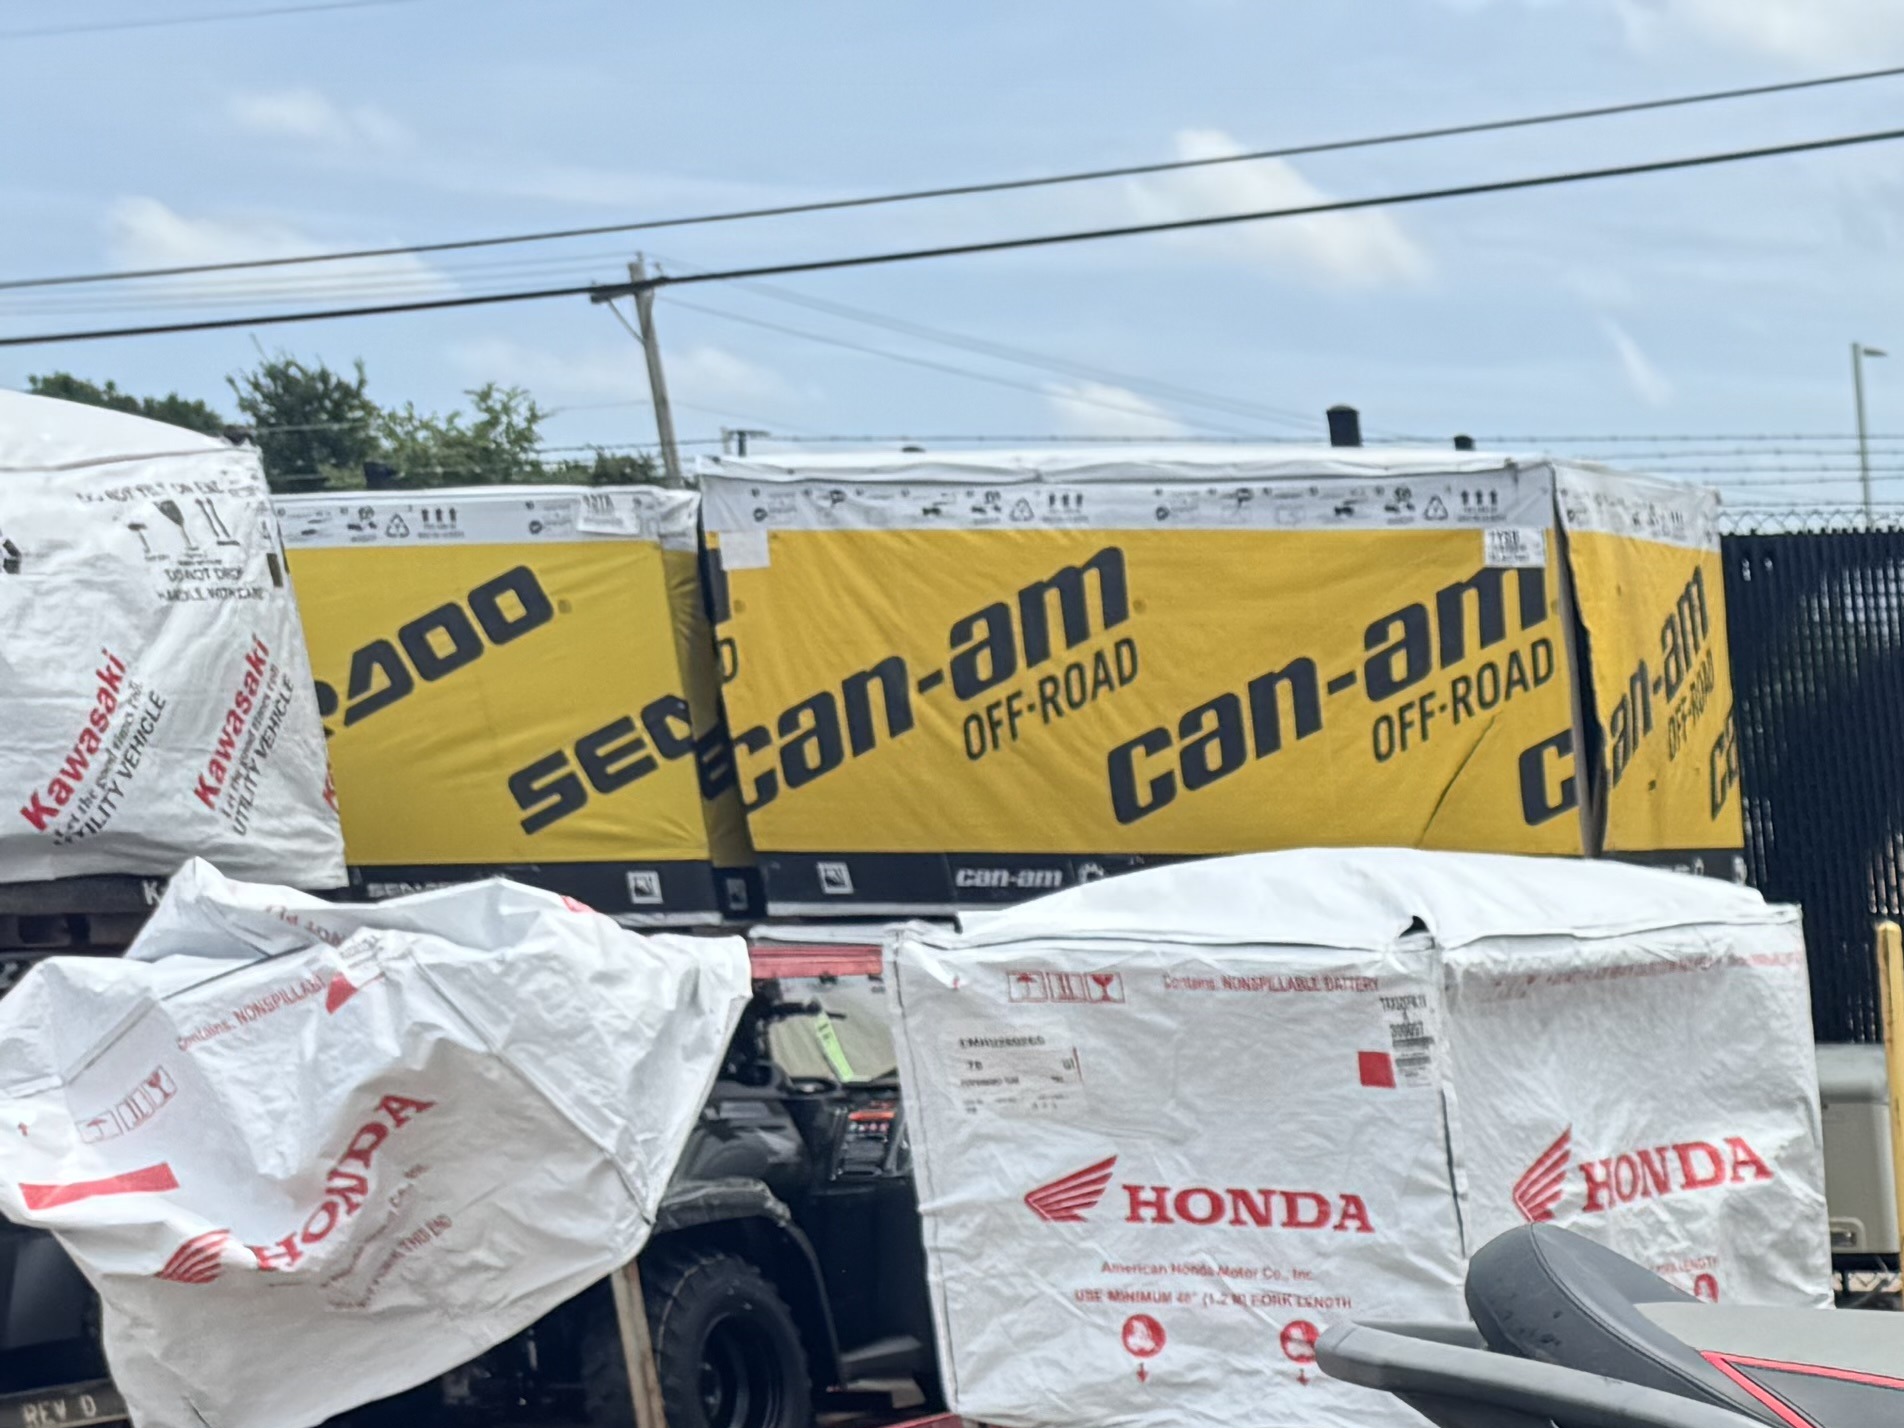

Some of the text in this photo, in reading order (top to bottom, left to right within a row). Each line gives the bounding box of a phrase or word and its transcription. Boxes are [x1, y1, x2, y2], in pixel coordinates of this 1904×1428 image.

[118, 692, 166, 779] VEHICLE
[193, 633, 270, 810] Kawasaki
[255, 674, 295, 757] VEHICLE
[963, 638, 1139, 761] OFF-ROAD
[1107, 566, 1545, 825] can-am
[1373, 637, 1555, 762] OFF-ROAD
[20, 648, 126, 831] Kawasaki
[246, 1094, 437, 1271] HONDA
[1122, 1183, 1374, 1233] HONDA
[1578, 1135, 1776, 1214] HONDA
[1101, 1261, 1168, 1275] American
[1171, 1263, 1217, 1277] Honda
[1218, 1265, 1259, 1279] Motor
[1107, 1289, 1172, 1304] MINIMUM
[22, 1394, 97, 1428] REV D
